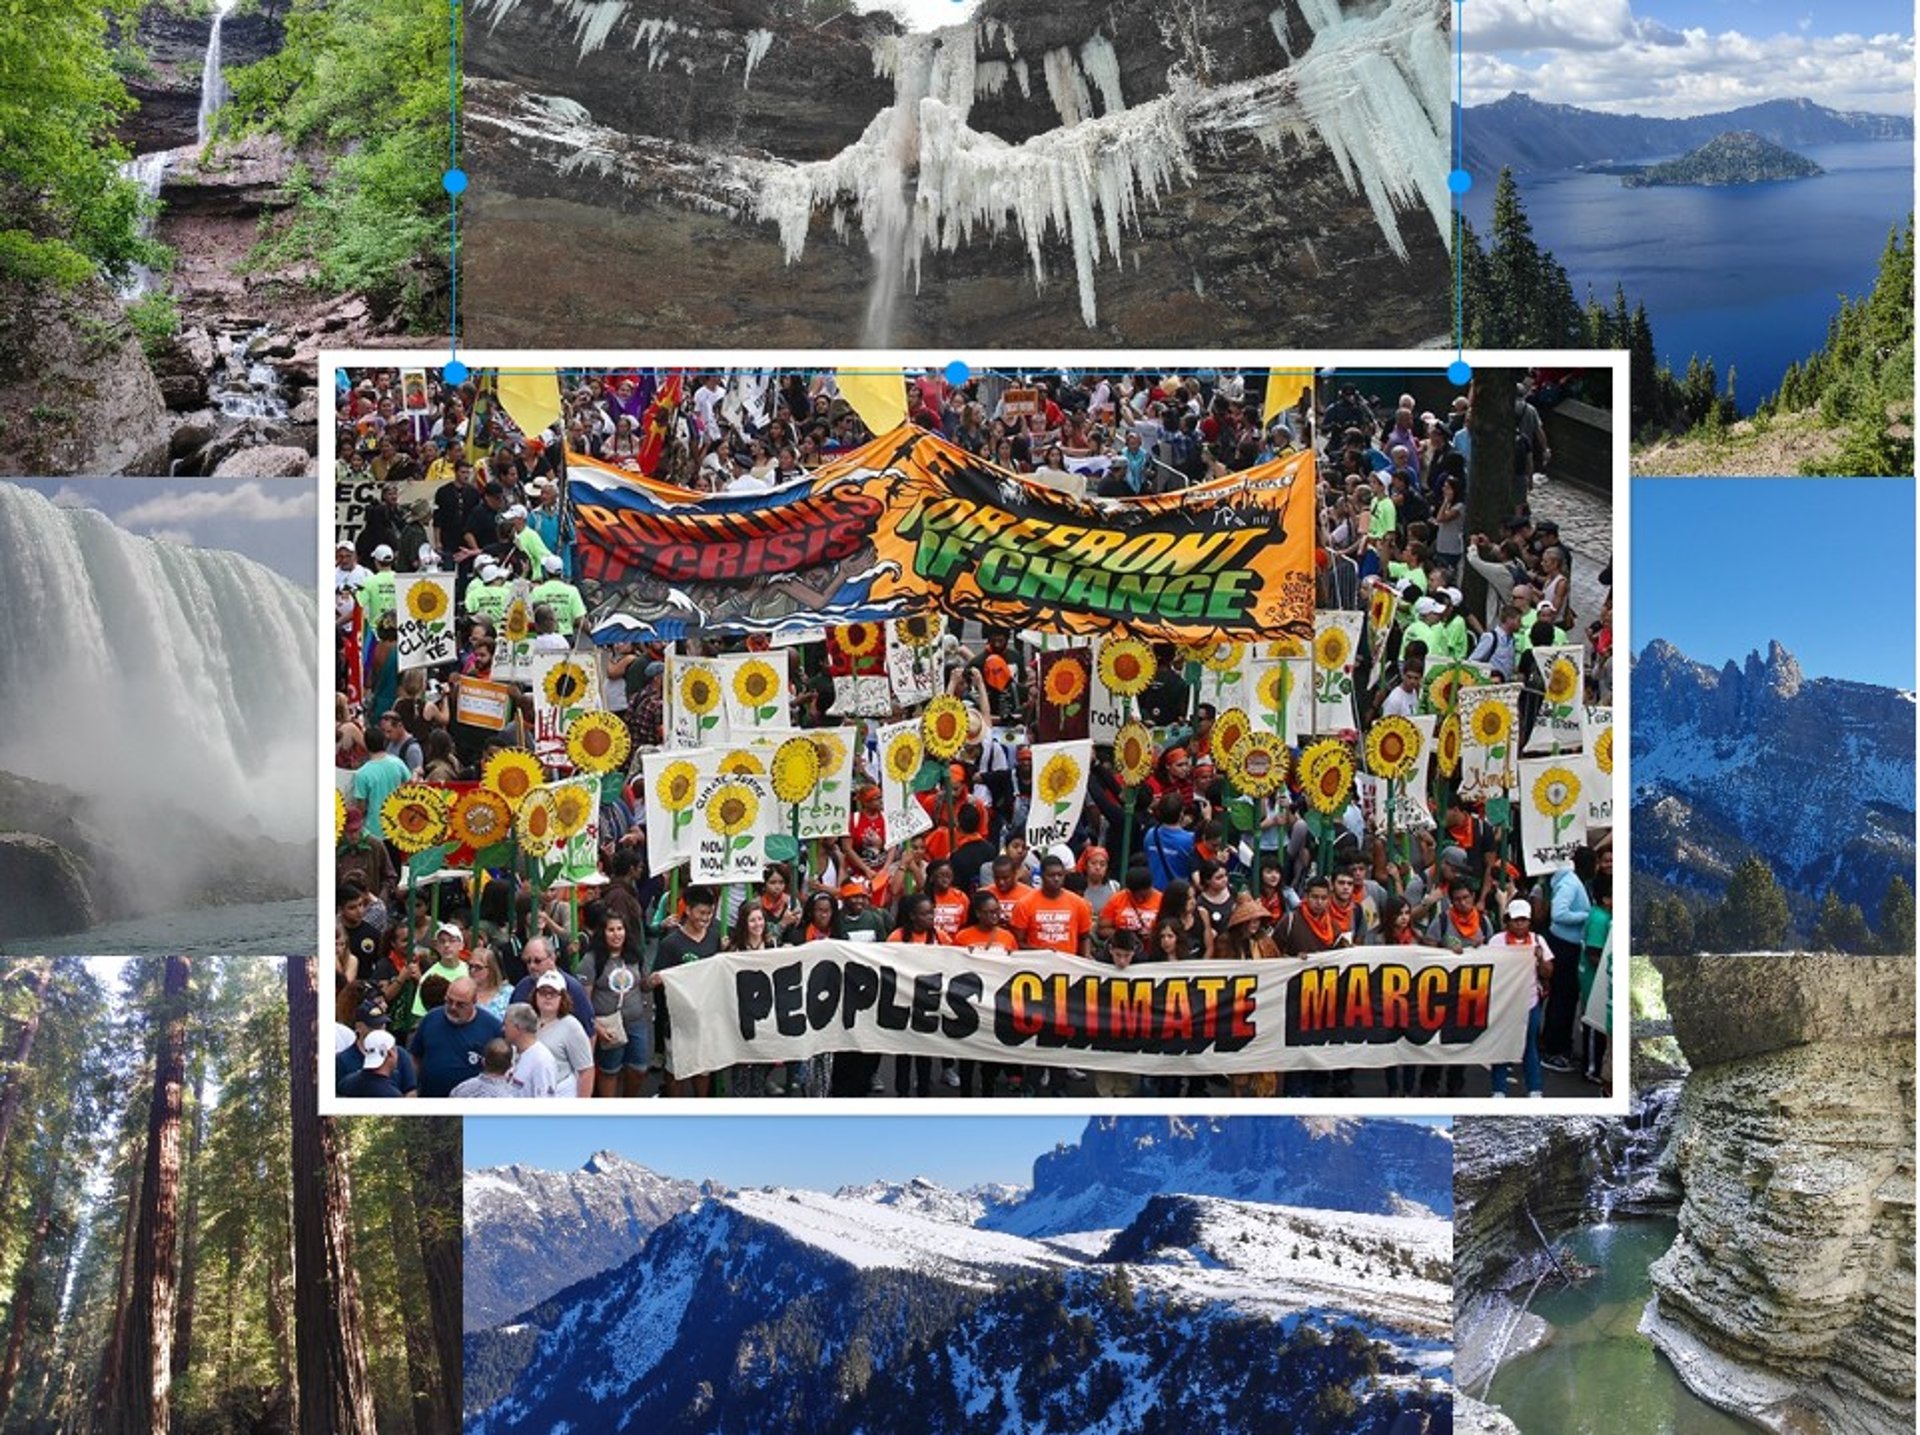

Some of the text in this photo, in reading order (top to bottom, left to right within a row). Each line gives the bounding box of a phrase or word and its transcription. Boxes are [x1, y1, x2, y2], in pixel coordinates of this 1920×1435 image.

[576, 484, 883, 546] RONTLINES
[650, 519, 865, 582] CRISIS
[974, 546, 1255, 620] CHANGE
[399, 619, 428, 640] FOR
[425, 645, 448, 661] TE
[696, 776, 728, 810] CLIMATE
[701, 840, 723, 853] NOW
[701, 855, 758, 871] NOW NOW
[735, 959, 1494, 1053] PEOPLES CLIMATE MARCH
